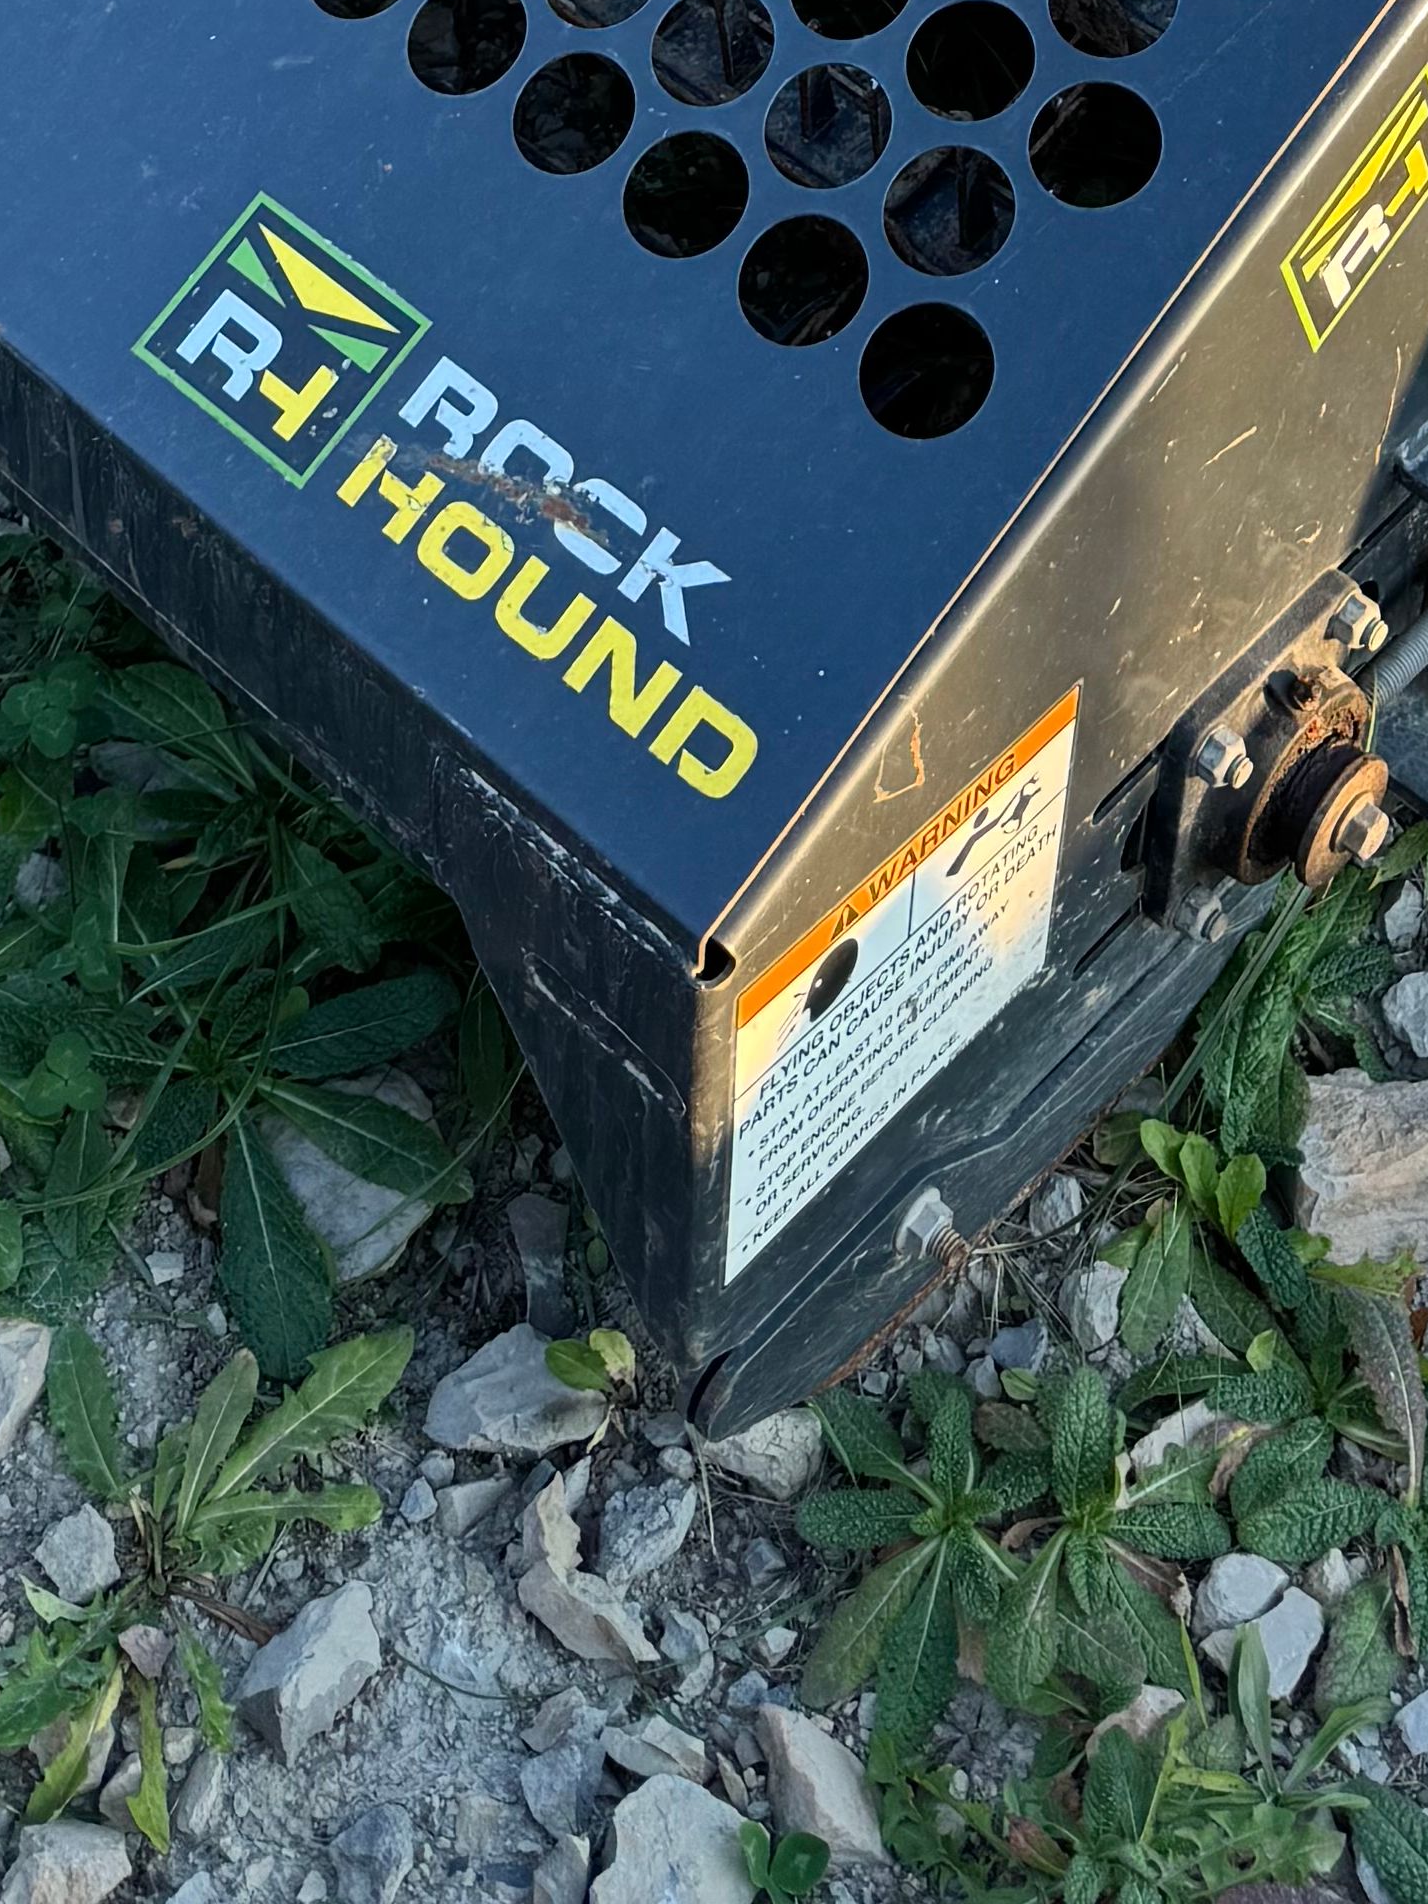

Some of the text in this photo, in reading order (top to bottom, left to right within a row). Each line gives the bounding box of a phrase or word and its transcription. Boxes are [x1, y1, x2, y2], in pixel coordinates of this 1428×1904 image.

[336, 433, 760, 799] HOUND
[398, 355, 733, 646] ROCK
[869, 752, 1015, 904] WARNING
[739, 823, 1057, 1140] PARTS CAN CAUSE INJURY OR DEATH
[755, 956, 994, 1198] STOP ENGINE BEFORE CLEANING
[759, 824, 1039, 1102] FLYING OBJECTS AND ROTATING
[759, 1109, 799, 1151] STAY
[802, 1080, 823, 1107] AT
[826, 1032, 874, 1086] LEAST
[878, 1014, 894, 1036] 10
[967, 899, 1010, 949] AWAY
[752, 1198, 793, 1245] KEEP
[796, 1171, 824, 1198] ALL
[827, 1104, 890, 1166] GUARDS
[893, 1083, 909, 1105] IN
[755, 1187, 778, 1217] OR
[759, 1121, 803, 1172] FROM
[807, 1033, 894, 1123] OPERATING
